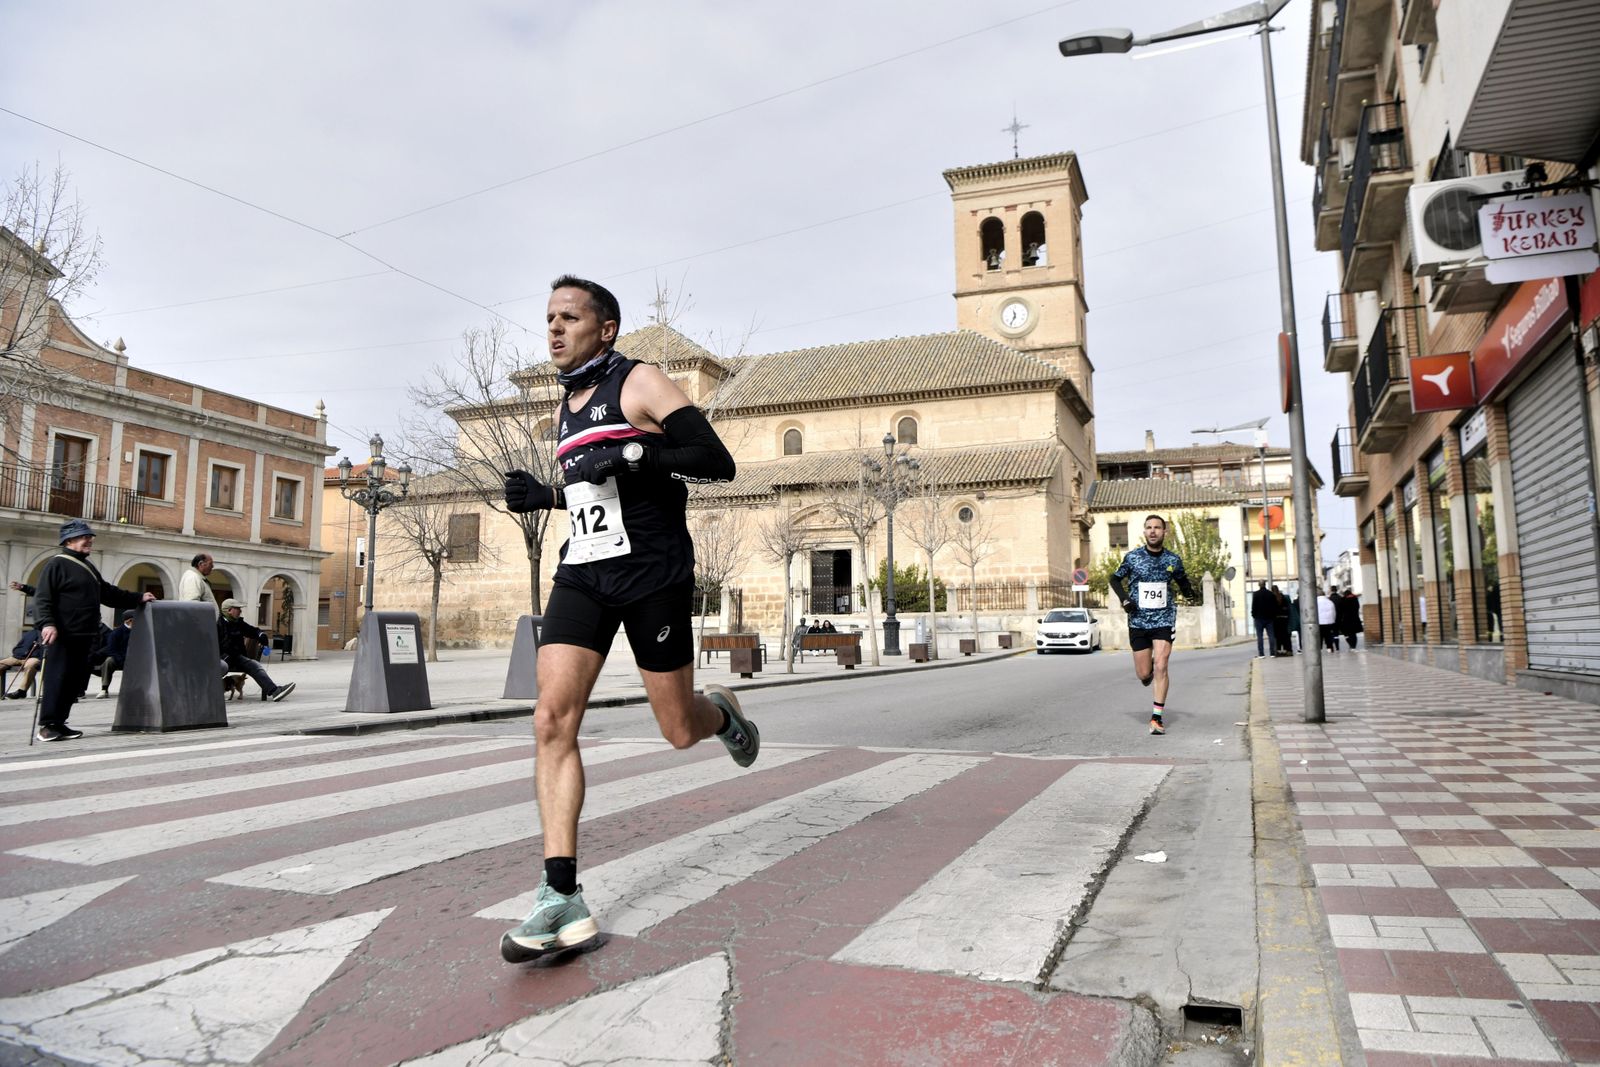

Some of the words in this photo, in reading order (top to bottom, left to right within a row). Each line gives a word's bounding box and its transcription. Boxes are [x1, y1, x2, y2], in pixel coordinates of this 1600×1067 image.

[1488, 203, 1585, 233] TURKEY
[1503, 229, 1577, 254] KEBAB
[1143, 590, 1163, 600] 794
